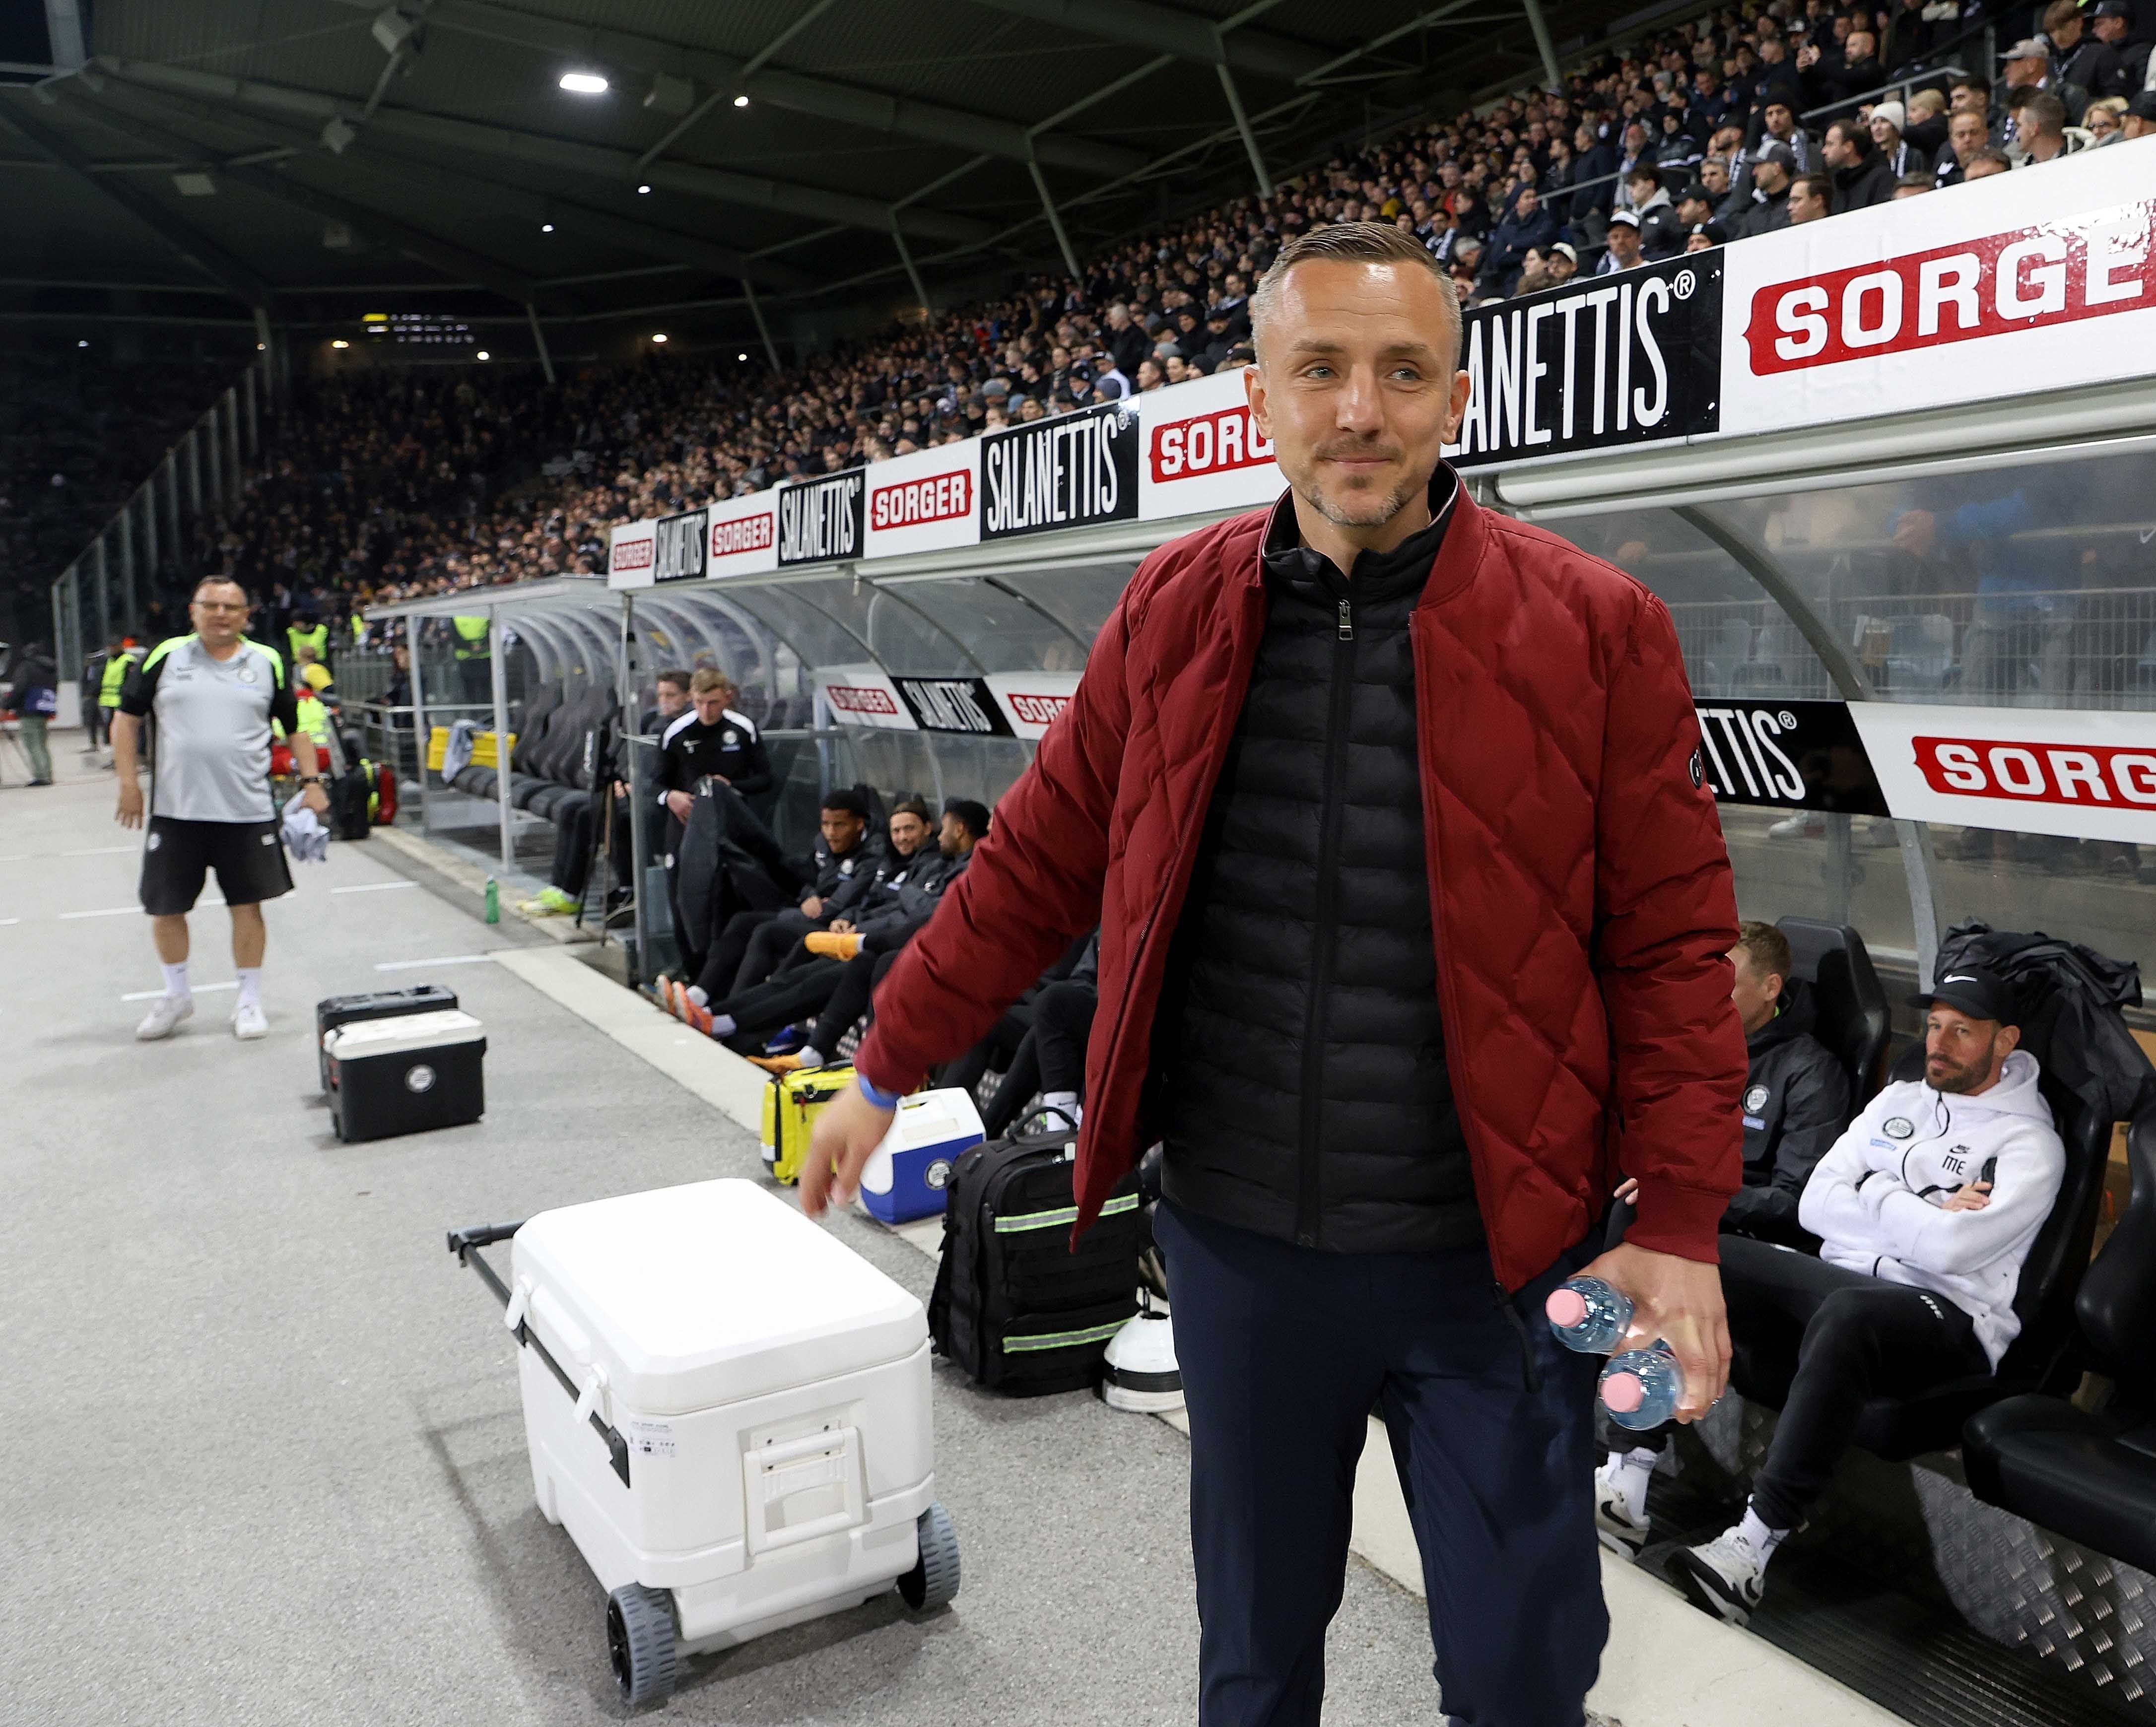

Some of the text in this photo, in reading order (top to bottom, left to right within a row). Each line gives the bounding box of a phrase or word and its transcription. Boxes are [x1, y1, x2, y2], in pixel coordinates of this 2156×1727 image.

[875, 474, 966, 527] SORGER
[714, 515, 770, 554] SORGER
[1942, 1155, 1966, 1176] ME
